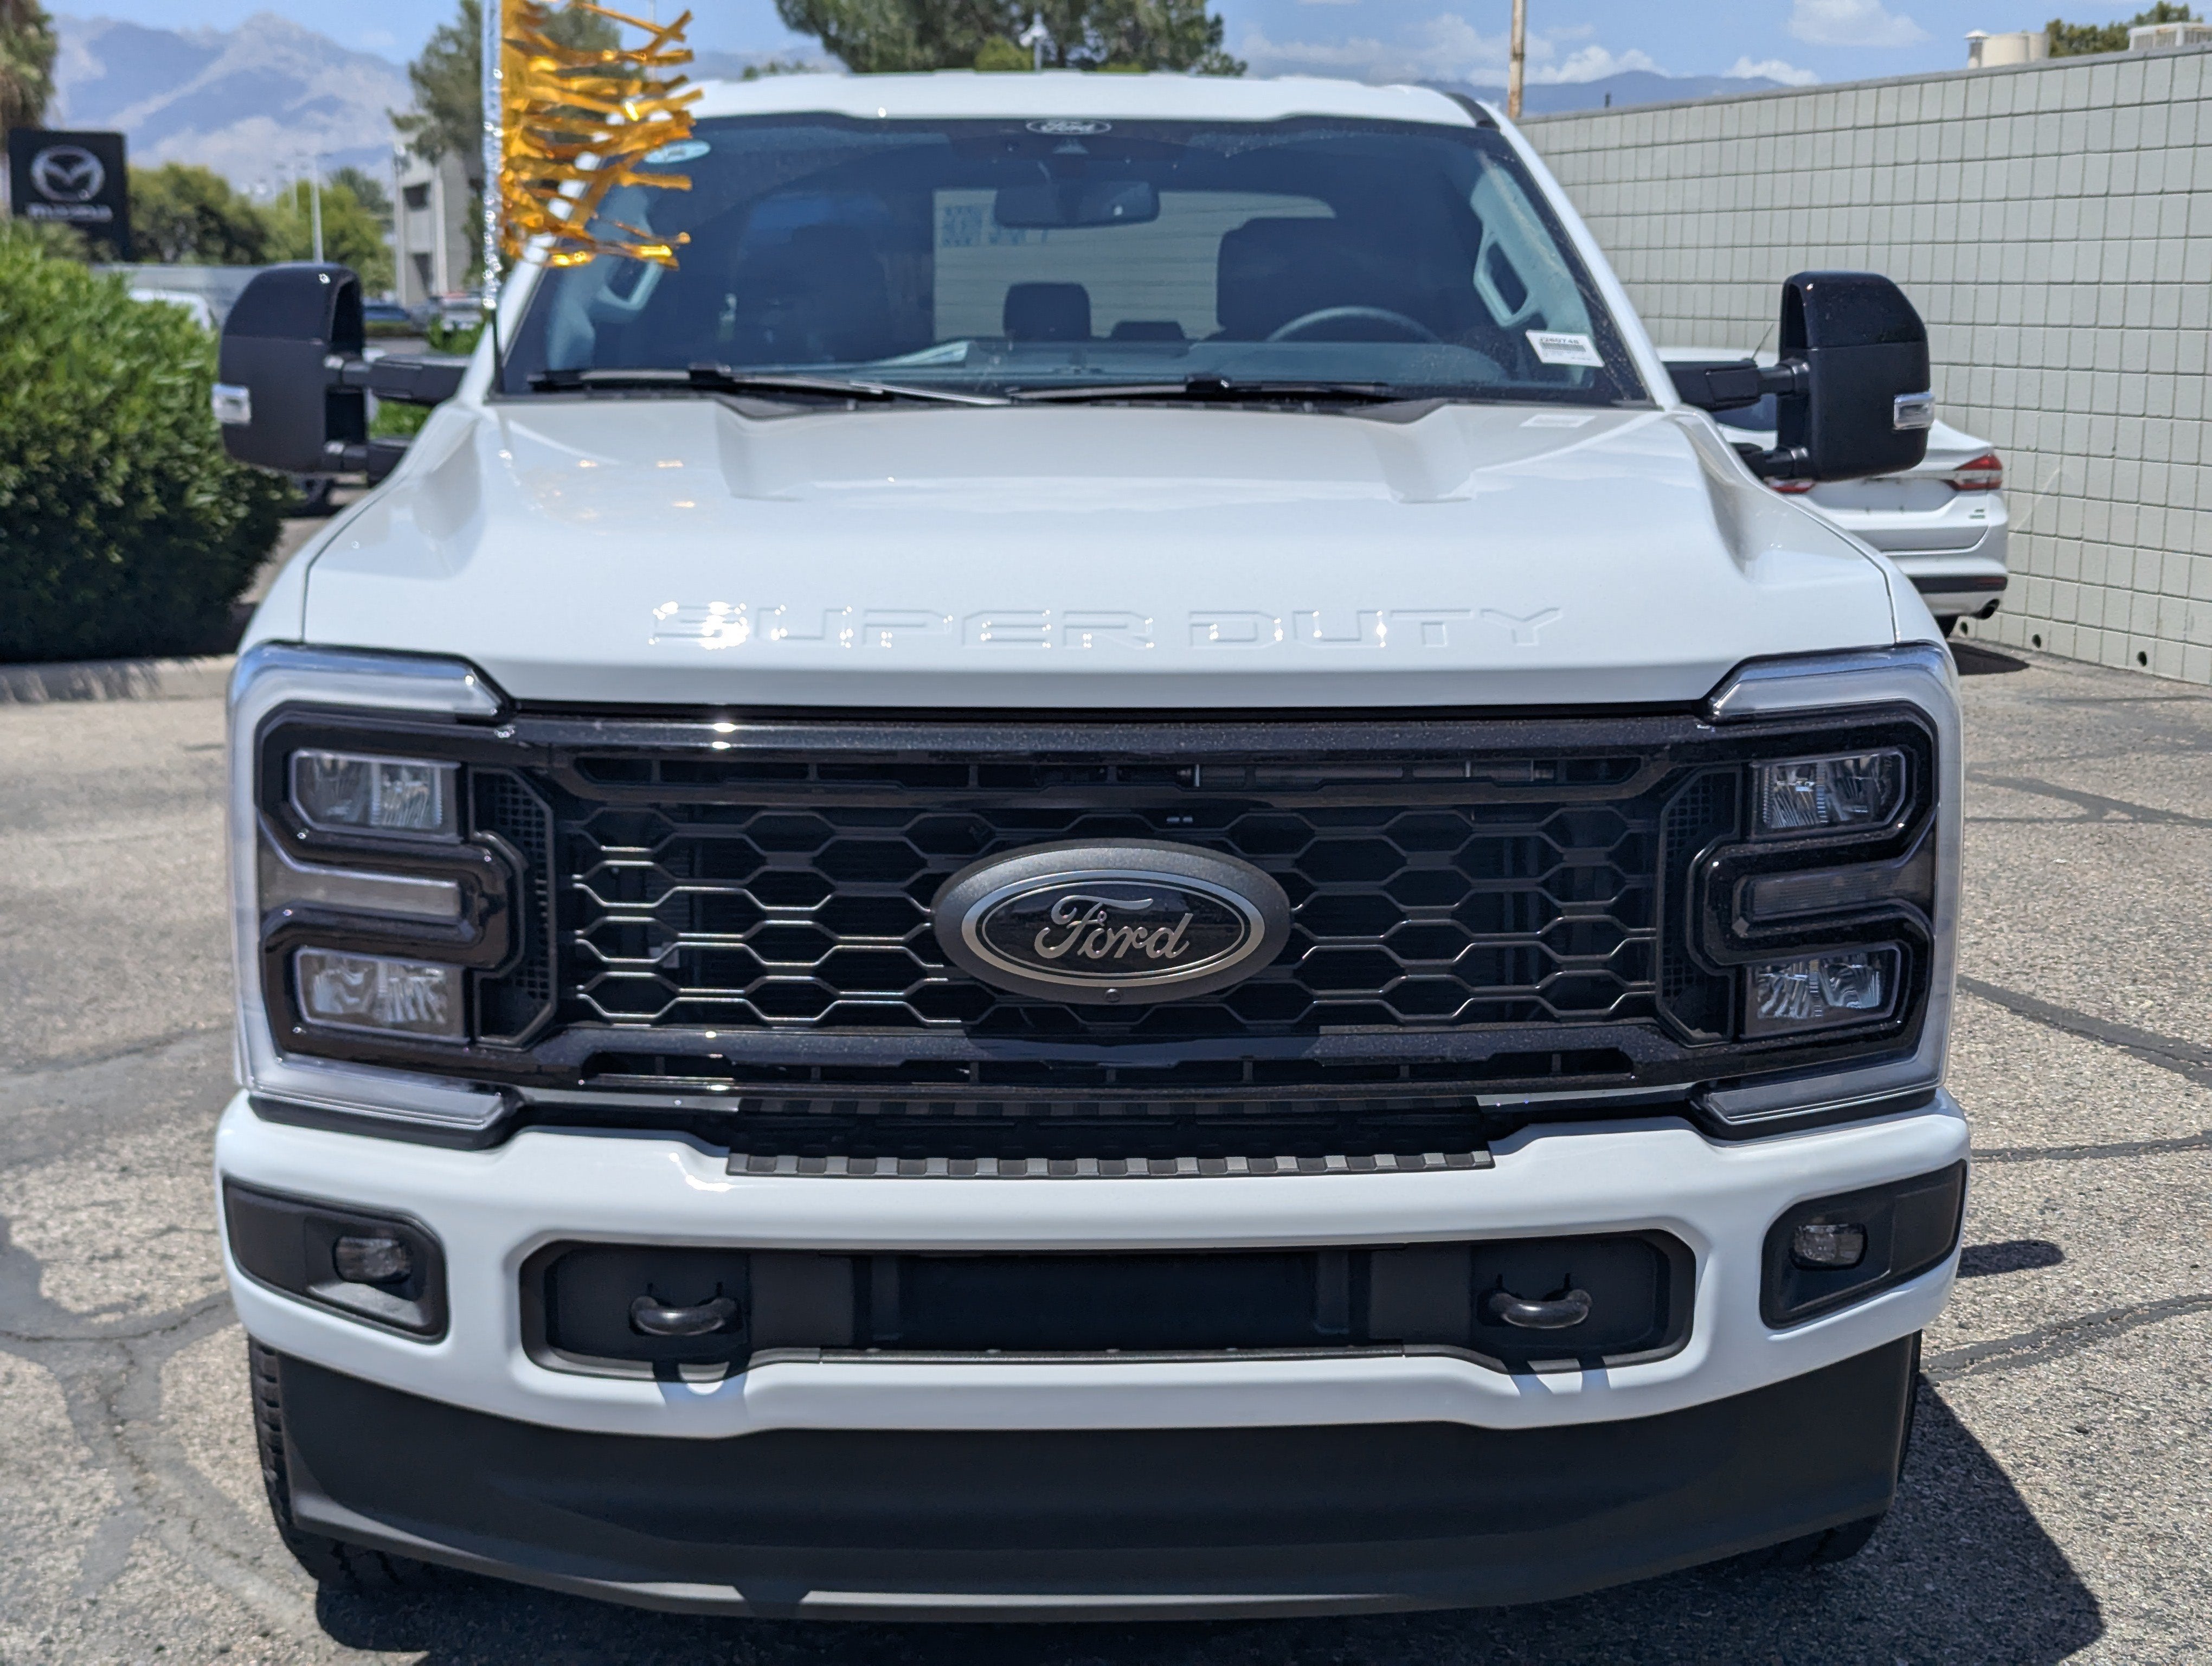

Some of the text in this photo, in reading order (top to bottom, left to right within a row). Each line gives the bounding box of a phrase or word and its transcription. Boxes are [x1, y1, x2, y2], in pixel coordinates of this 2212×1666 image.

[648, 601, 1564, 650] SUPER DUTY
[1034, 894, 1194, 958] Ford
